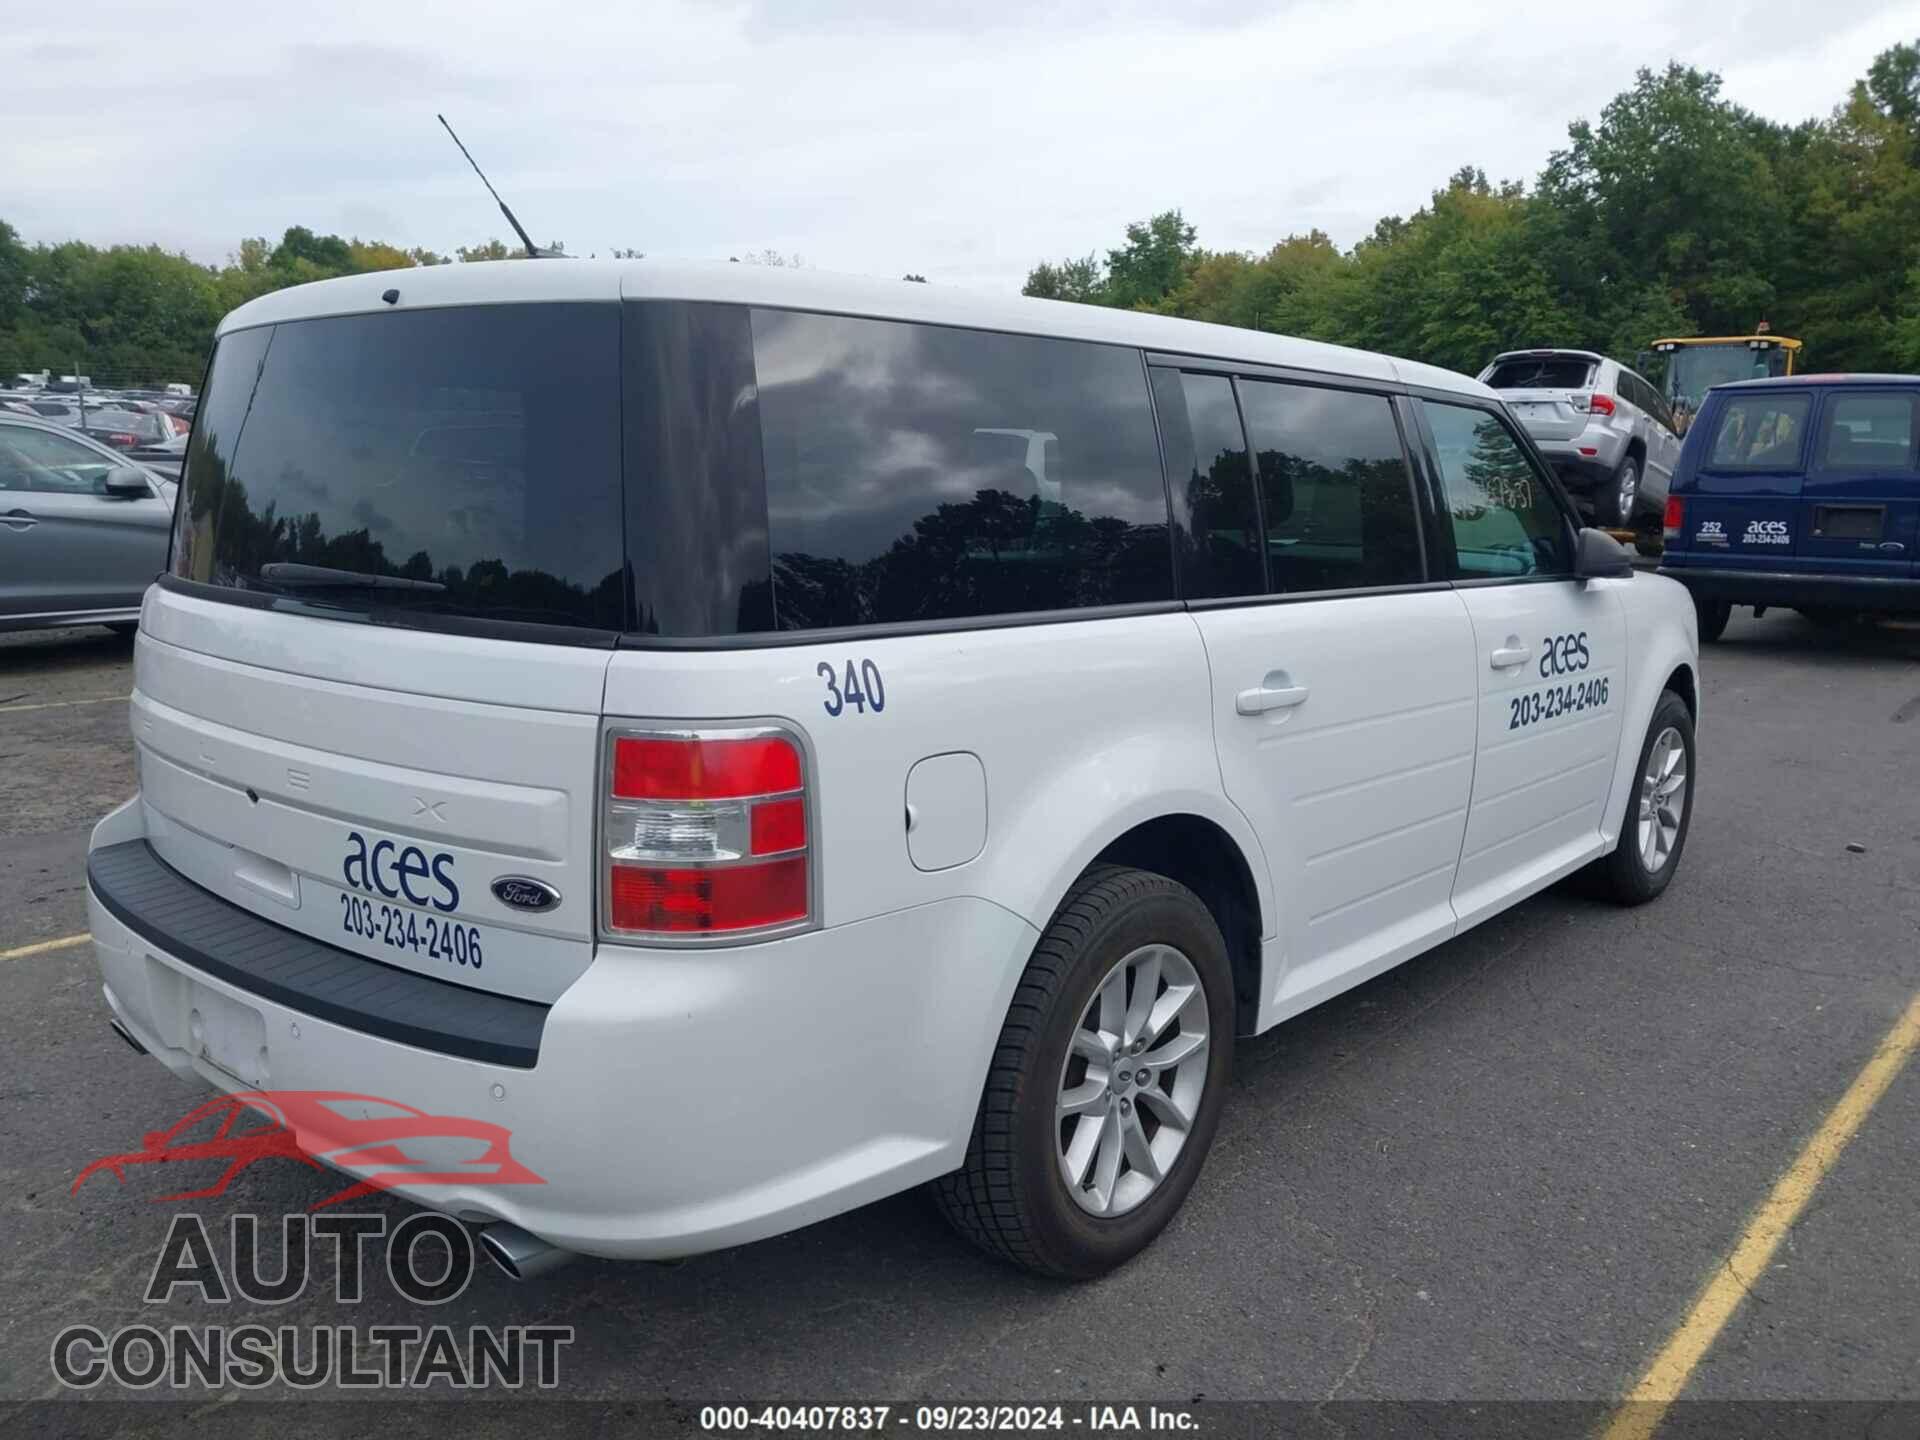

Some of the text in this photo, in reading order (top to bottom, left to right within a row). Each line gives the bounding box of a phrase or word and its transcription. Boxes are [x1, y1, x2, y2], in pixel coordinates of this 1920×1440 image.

[1701, 521, 1722, 533] 252
[1747, 520, 1788, 534] aces
[1540, 631, 1589, 678] aces
[817, 658, 885, 717] 340
[1510, 677, 1609, 730] 203-234-2406
[343, 832, 460, 913] aces
[341, 893, 483, 970] 203-234-2406
